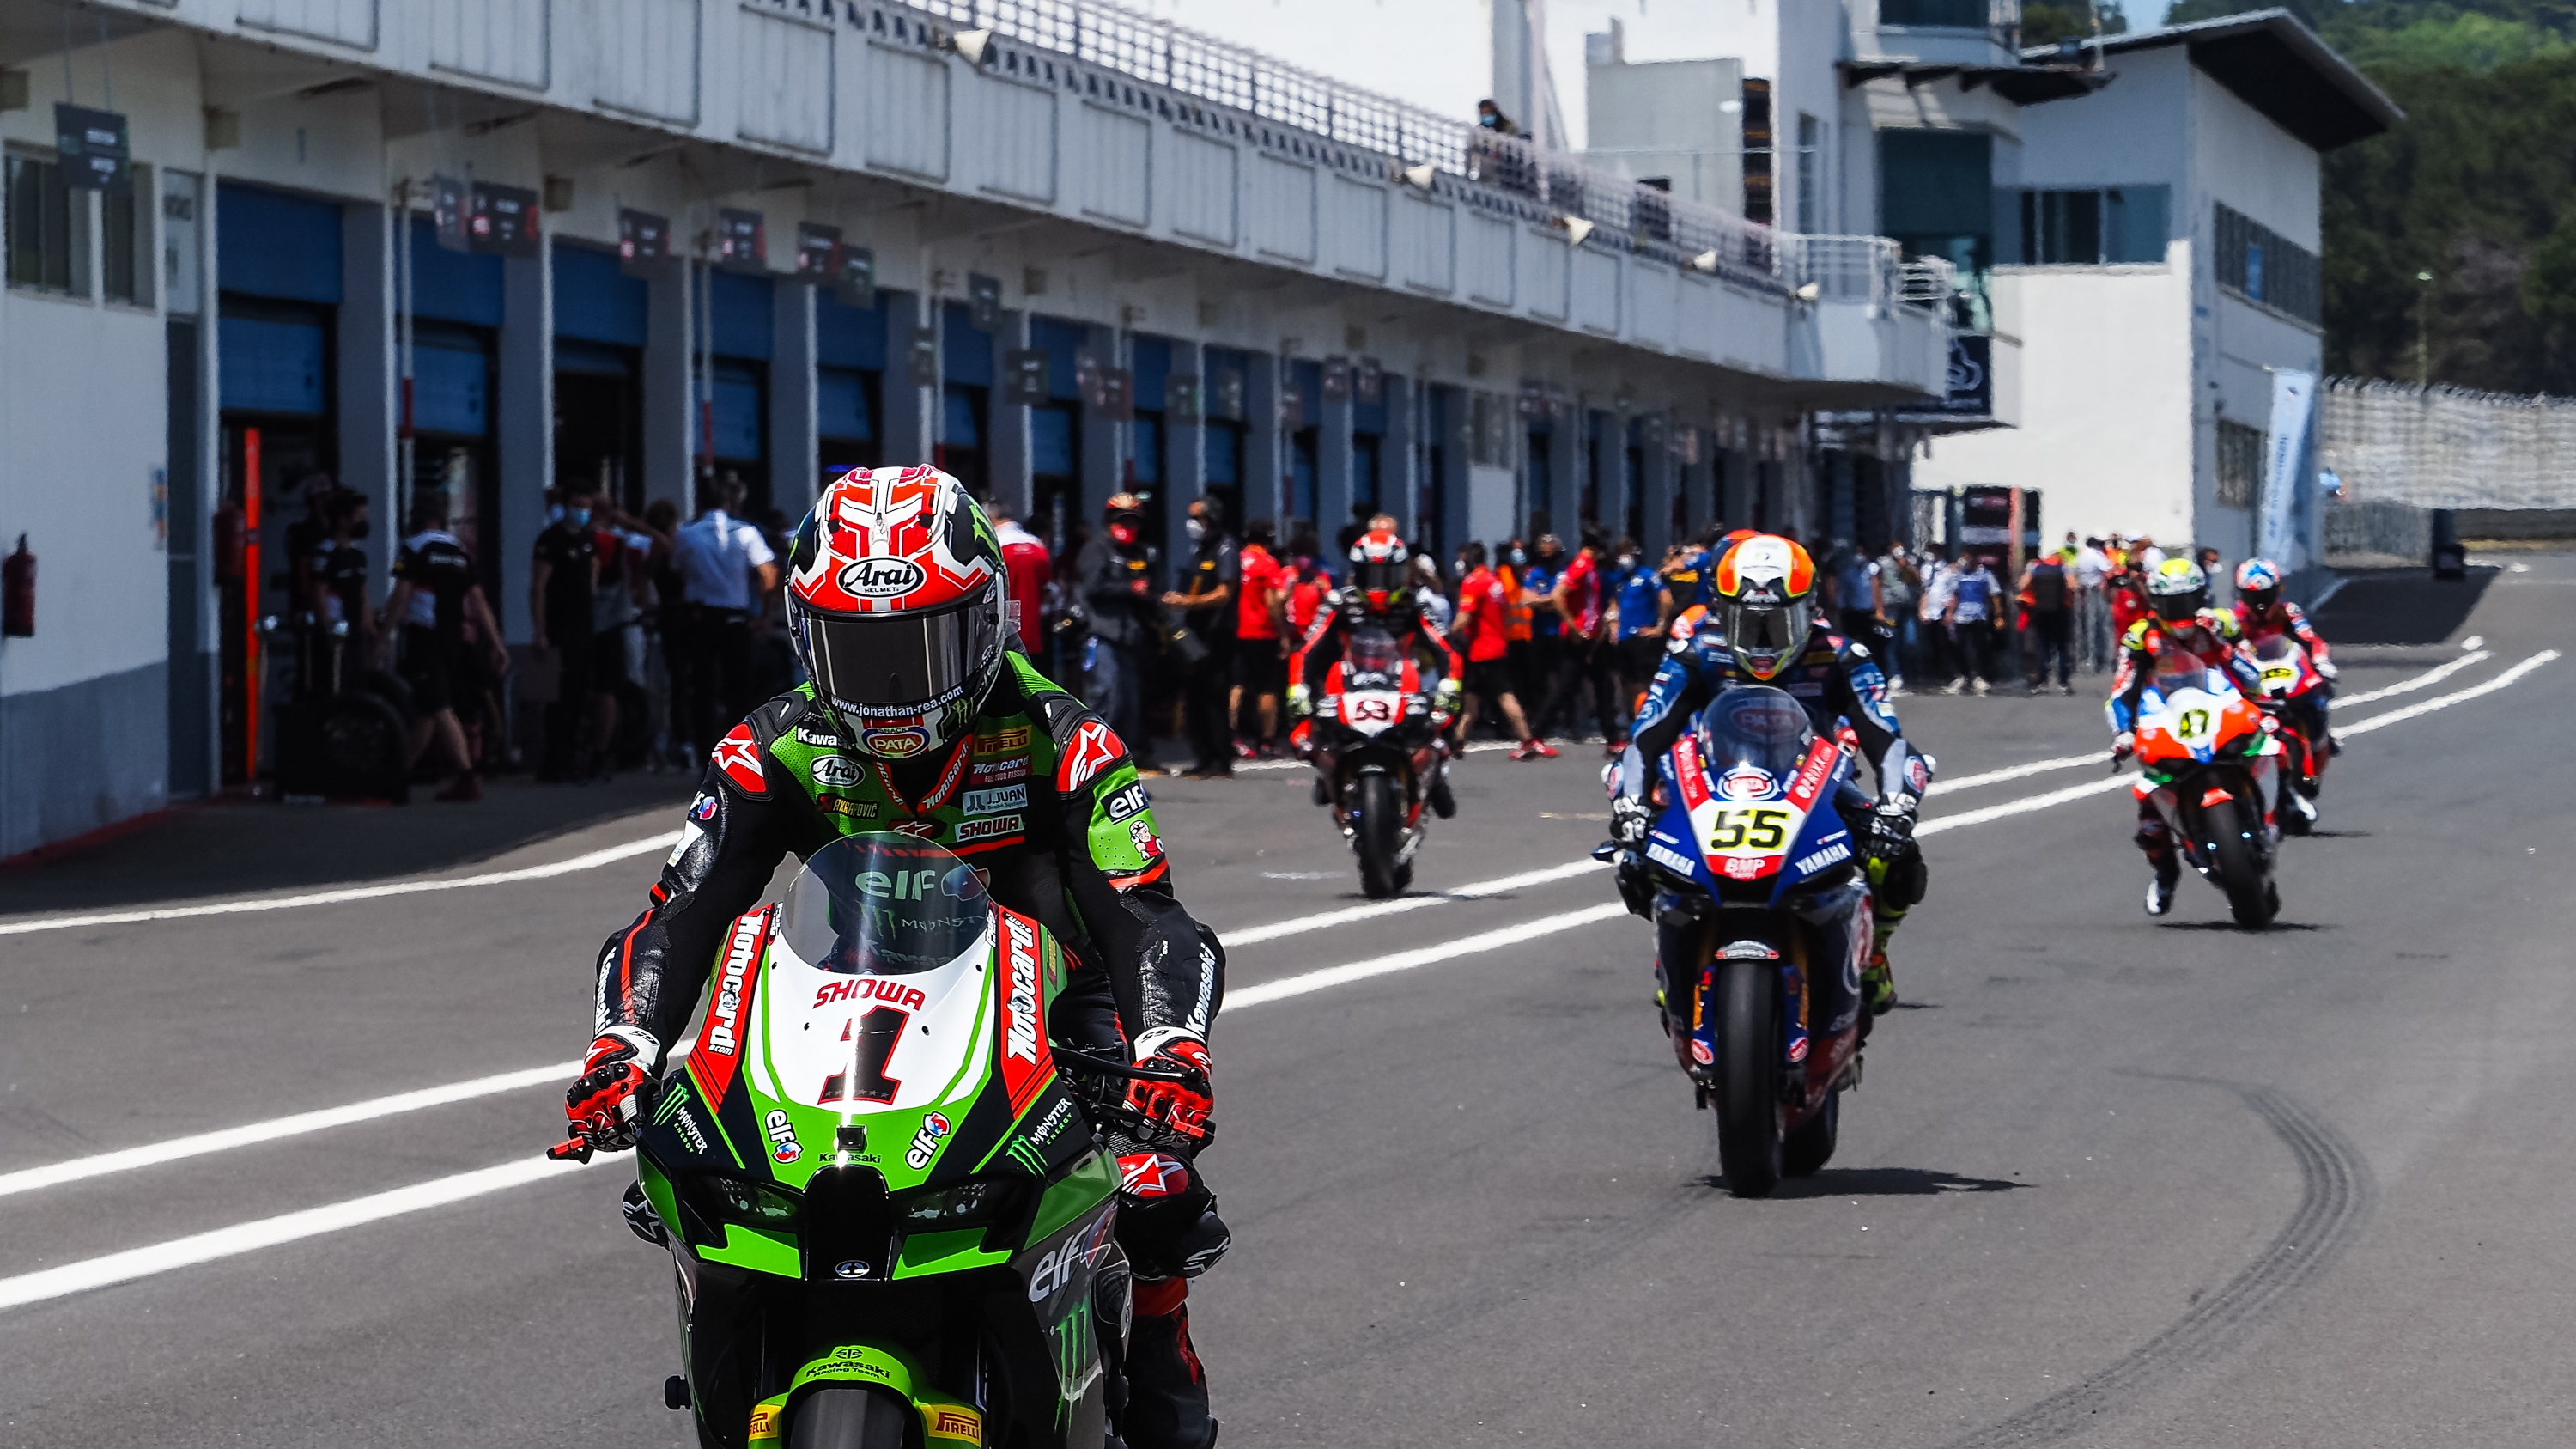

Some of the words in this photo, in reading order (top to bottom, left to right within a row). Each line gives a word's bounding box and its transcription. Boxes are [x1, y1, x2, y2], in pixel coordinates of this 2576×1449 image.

[843, 563, 913, 588] Arai
[830, 685, 963, 718] www.jonathan-rea.com
[873, 737, 917, 751] PATA
[813, 759, 857, 781] Arai
[987, 788, 1025, 805] J.JUAN
[1109, 784, 1145, 818] elf
[958, 816, 1020, 839] SHOWA
[1710, 809, 1789, 850] 55
[1795, 843, 1852, 875] YAMAHA
[854, 869, 936, 901] elf
[811, 978, 926, 1012] SHOWA
[817, 1004, 911, 1106] 1
[764, 1109, 797, 1145] elf
[819, 1153, 881, 1164] Kaasaki
[905, 1128, 939, 1170] elf
[1028, 1223, 1091, 1302] elf
[805, 1361, 890, 1379] Kawasaki
[935, 1412, 980, 1440] PIRELLI
